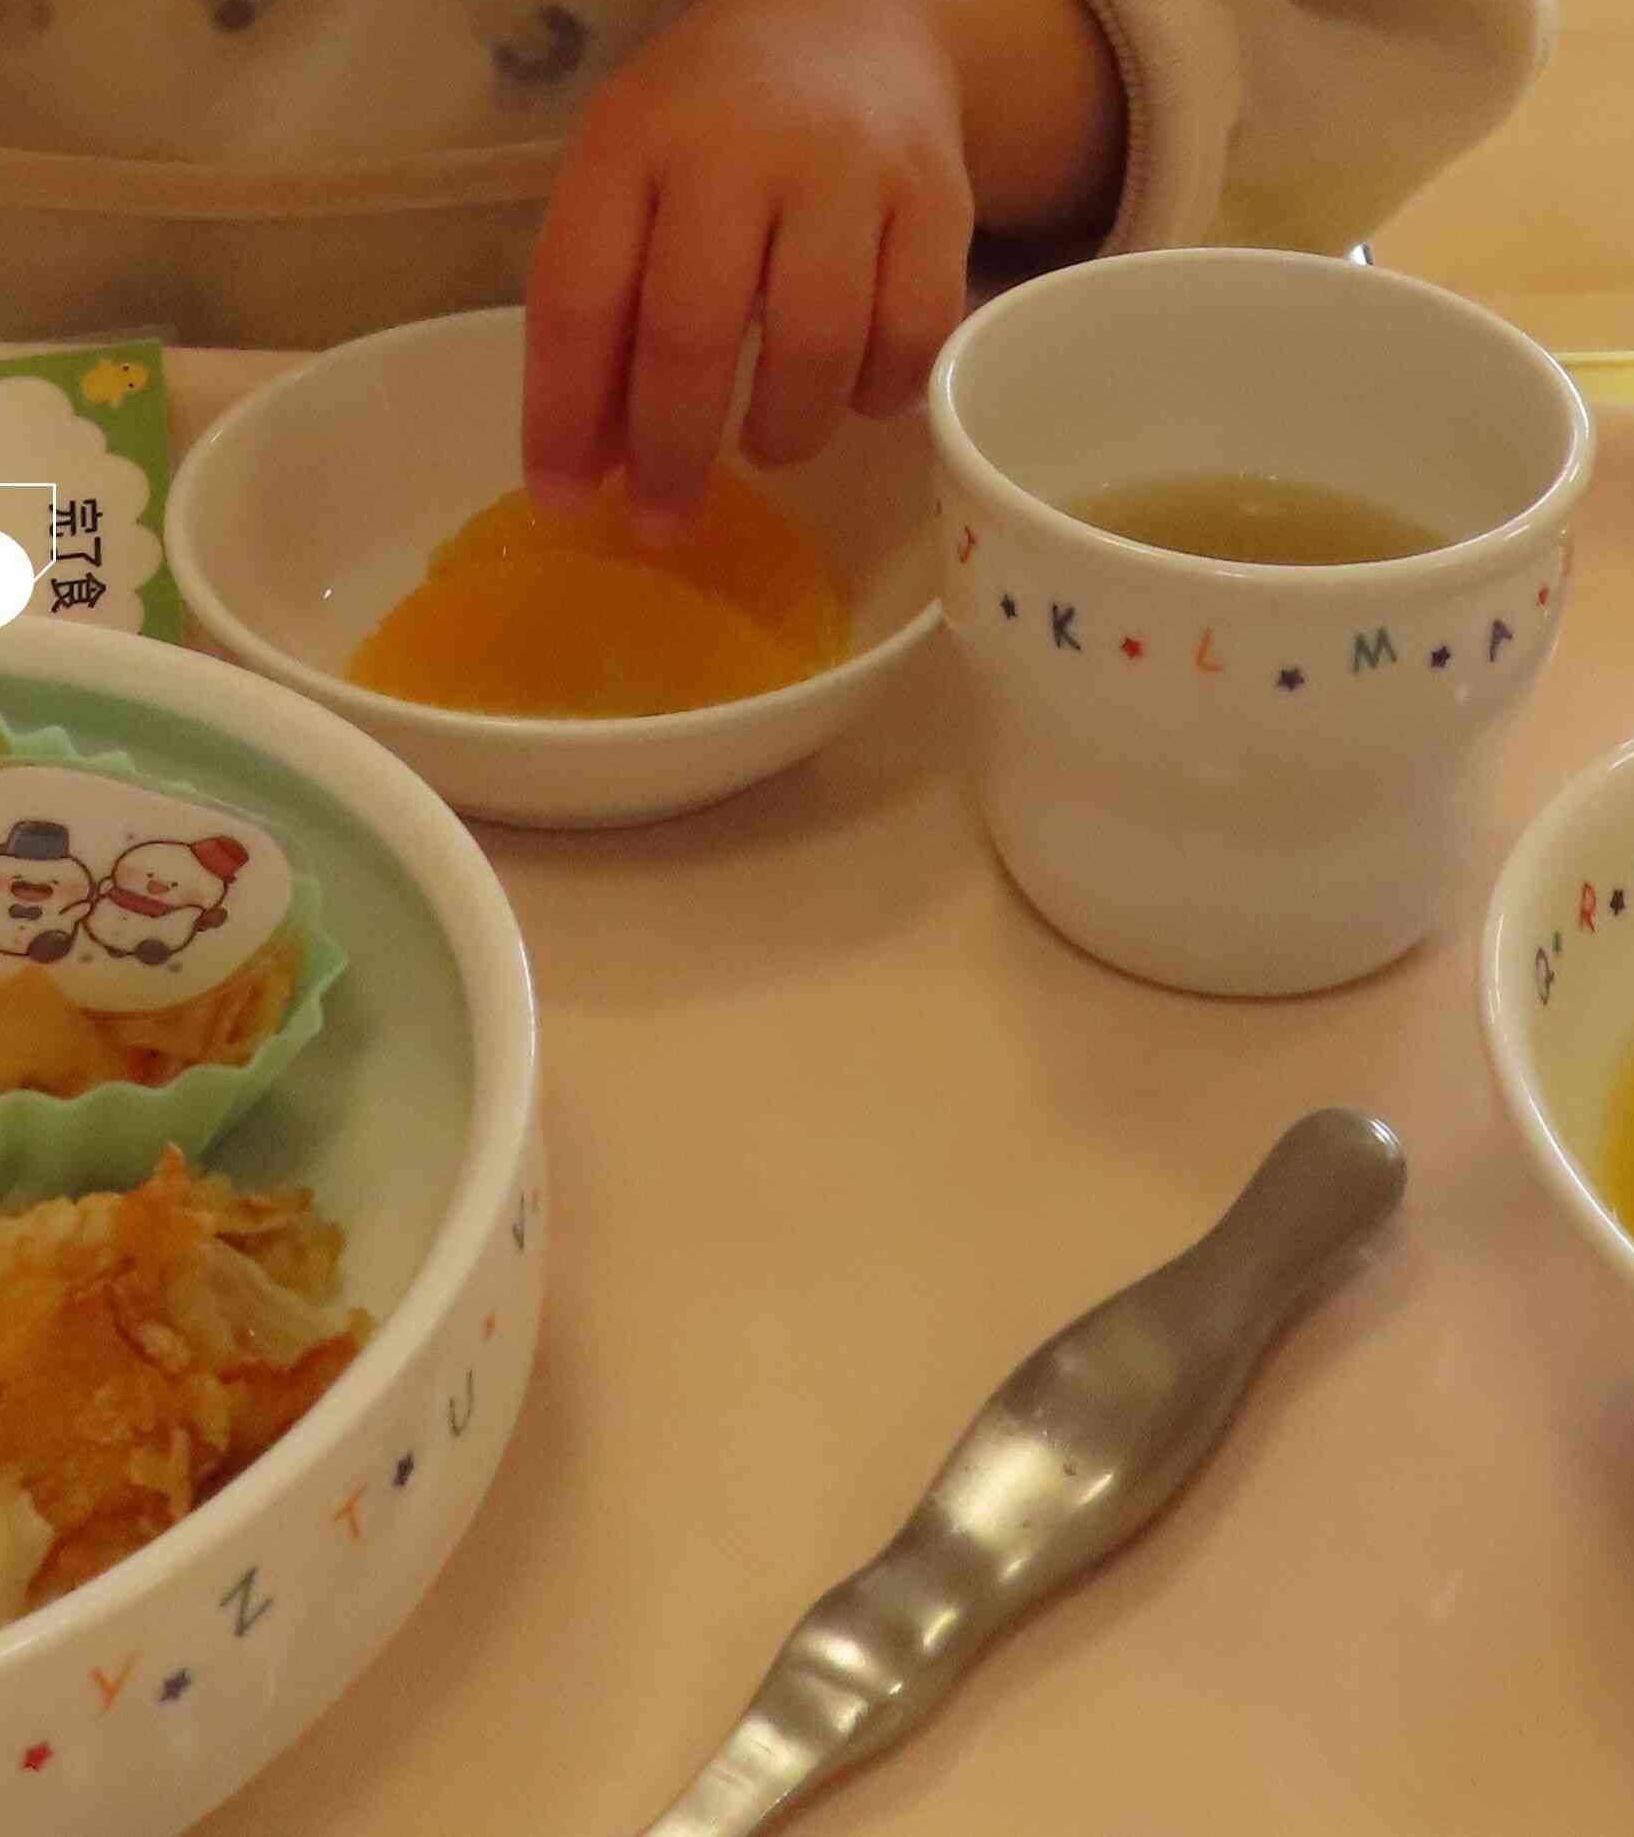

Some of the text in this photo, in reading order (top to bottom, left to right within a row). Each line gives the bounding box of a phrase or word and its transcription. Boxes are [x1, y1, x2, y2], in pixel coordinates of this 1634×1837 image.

[49, 498, 106, 613] 完了食
[1051, 601, 1083, 653] K
[1195, 625, 1225, 674] L
[1352, 626, 1397, 676] M
[1580, 882, 1597, 932] R
[91, 1655, 138, 1717] Y
[332, 1483, 368, 1540] T
